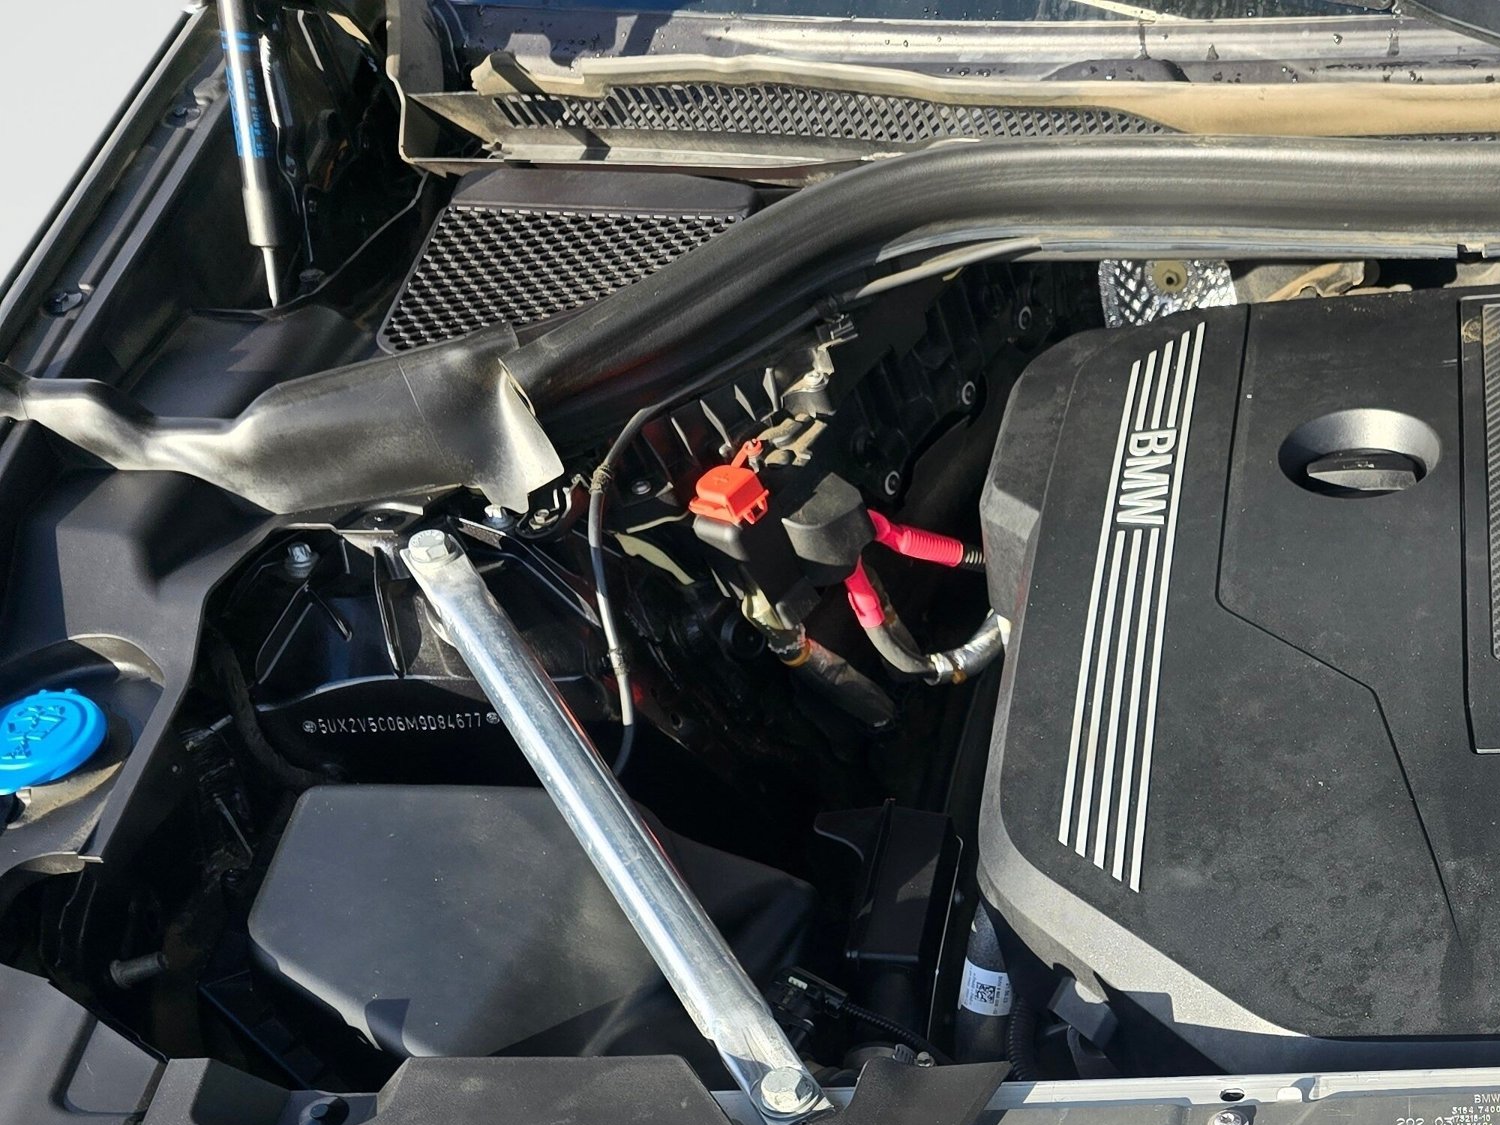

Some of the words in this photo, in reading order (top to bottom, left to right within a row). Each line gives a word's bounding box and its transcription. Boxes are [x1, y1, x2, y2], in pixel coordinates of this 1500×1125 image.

[1116, 429, 1177, 525] BMW
[317, 712, 481, 734] 5UX2V5C06M9D84677
[1473, 1093, 1500, 1104] BMW
